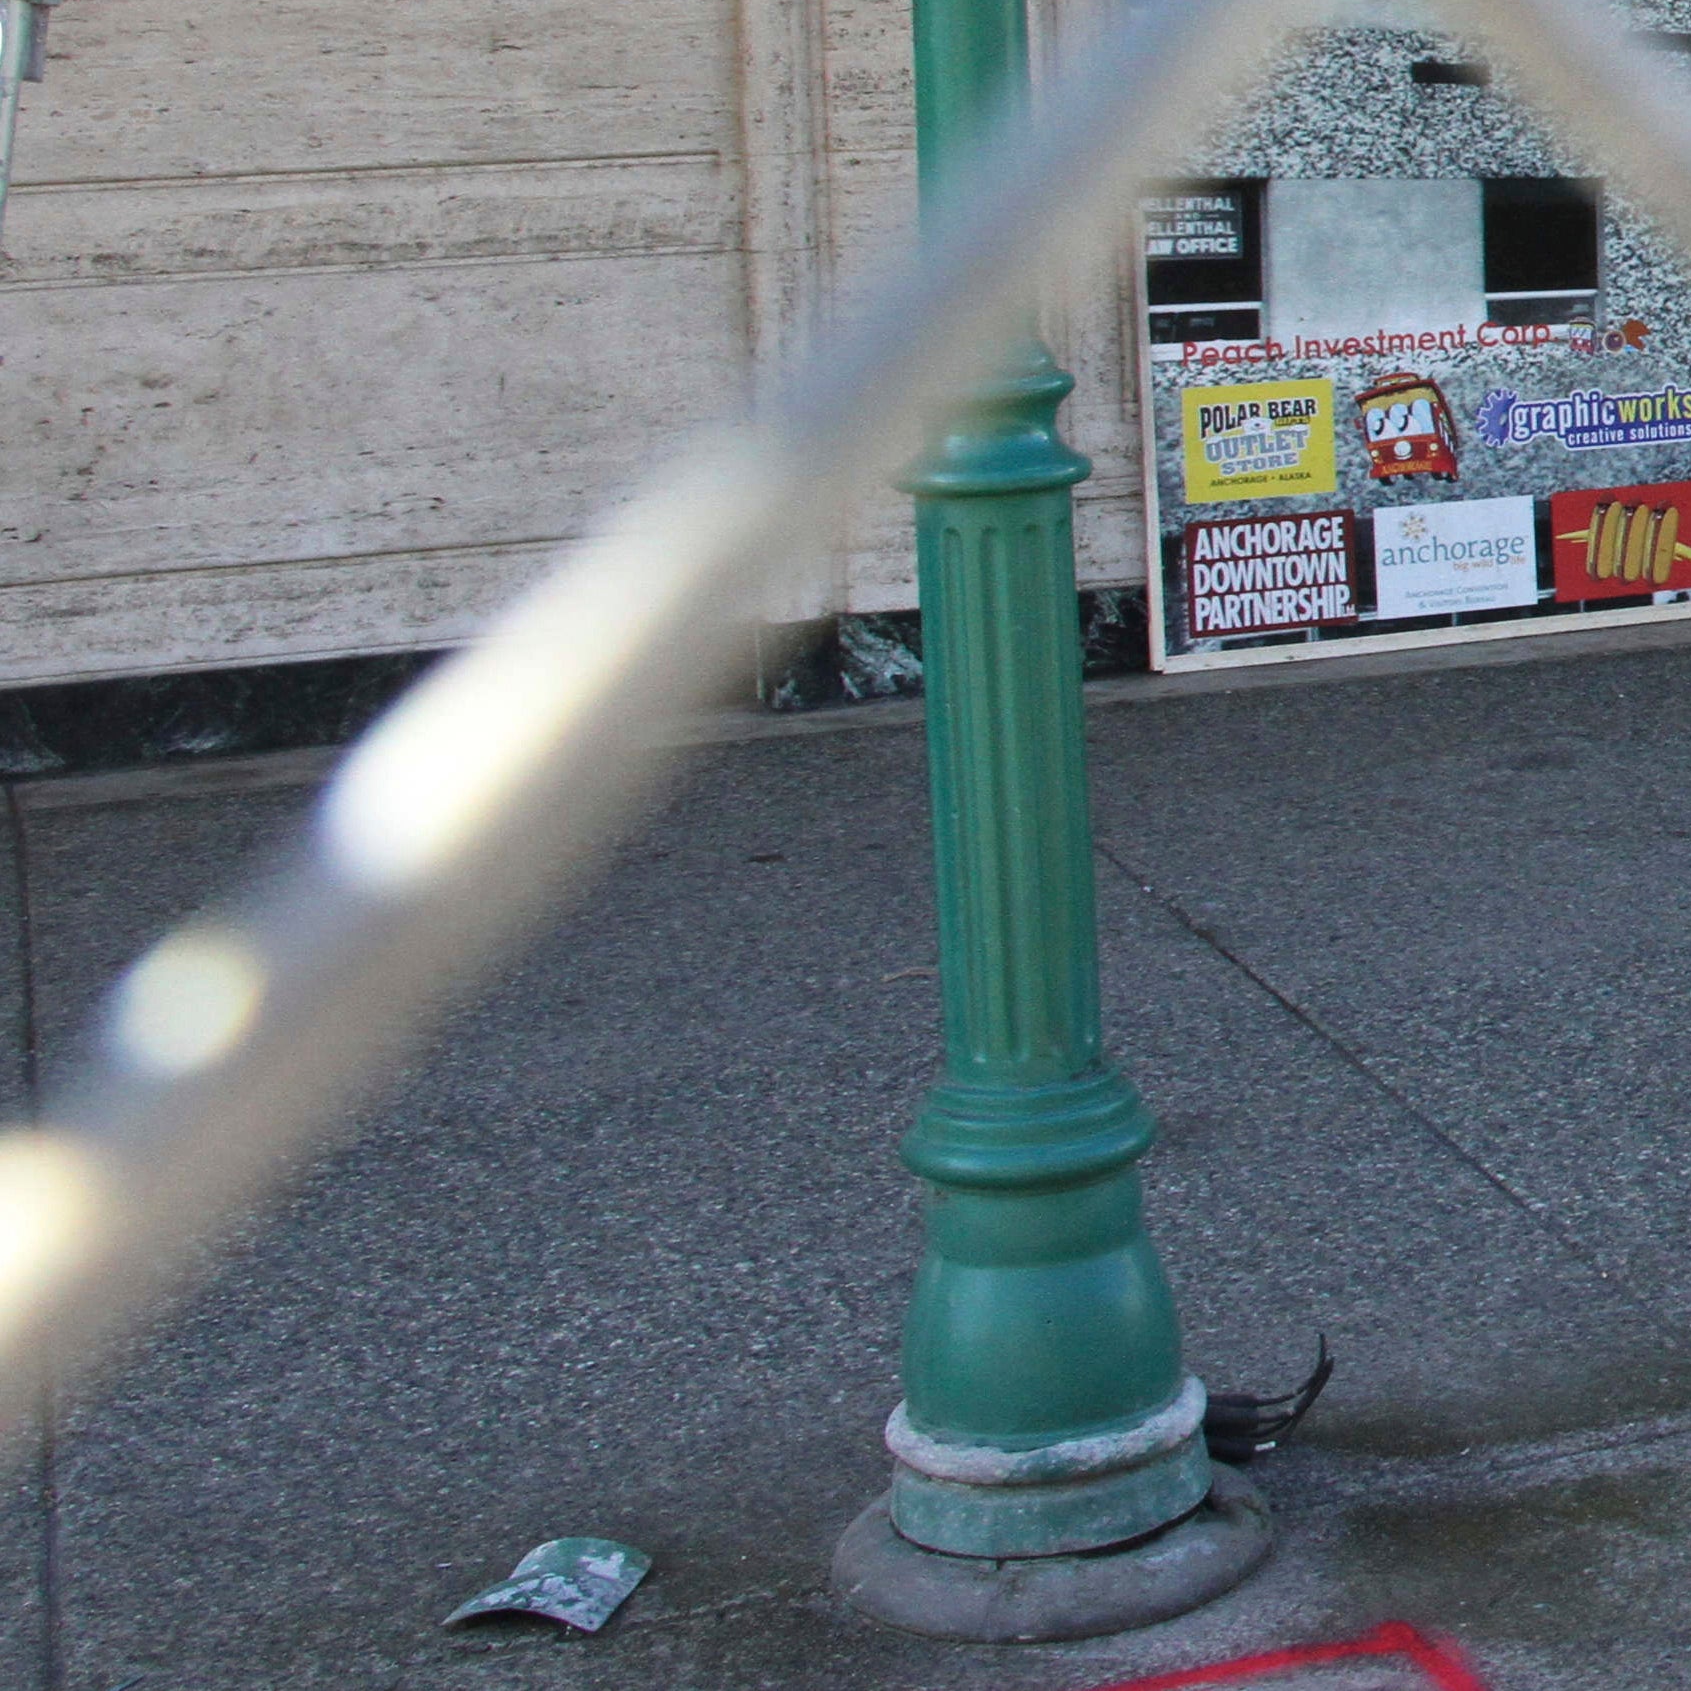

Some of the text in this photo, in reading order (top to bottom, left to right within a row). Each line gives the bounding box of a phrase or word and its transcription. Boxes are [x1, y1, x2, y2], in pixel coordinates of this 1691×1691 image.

[1147, 220, 1236, 236] ELLENTHAL
[1147, 236, 1239, 255] AW OFFICE
[1182, 321, 1558, 368] Peach Investment Corp.
[1200, 403, 1262, 439] POLAR
[1267, 398, 1317, 420] BEAR
[1204, 428, 1310, 463] OUTLET
[1568, 428, 1624, 446] creative
[1210, 471, 1312, 488] ANCHORAGE ALASKA
[1221, 452, 1298, 476] STORE
[1193, 516, 1345, 561] ANCHORAGE
[1382, 535, 1526, 567] anchorage
[1193, 552, 1347, 596] DOWNTOWN
[1453, 559, 1469, 572] big
[1195, 584, 1350, 632] PARTNERSHIP
